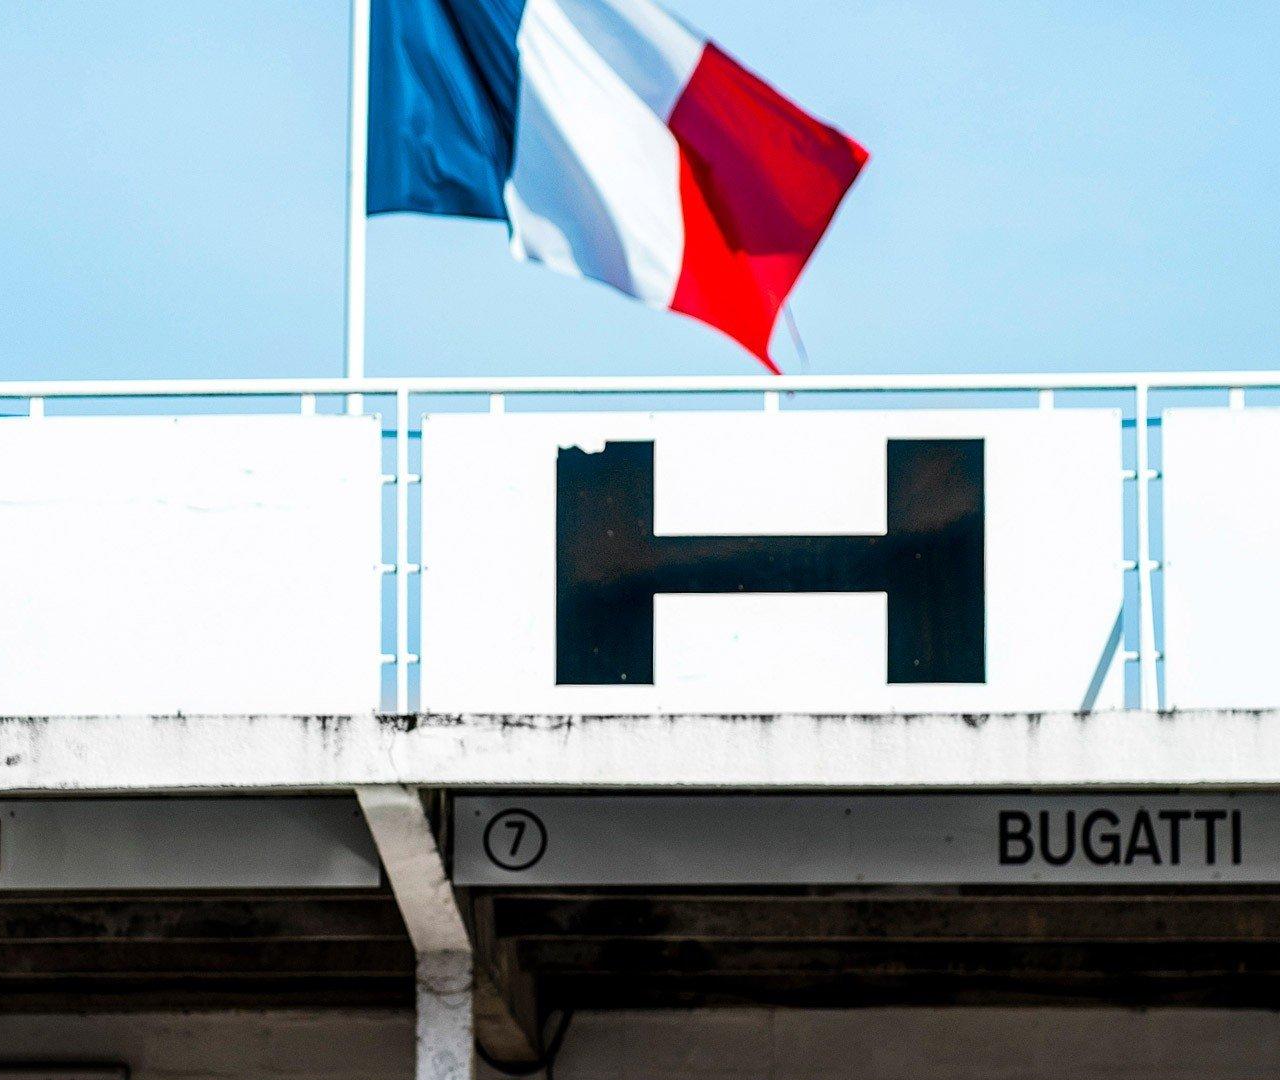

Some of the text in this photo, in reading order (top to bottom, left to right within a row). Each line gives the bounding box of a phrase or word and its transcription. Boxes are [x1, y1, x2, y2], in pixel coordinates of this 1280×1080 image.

[556, 438, 987, 686] H
[503, 819, 527, 857] 7
[997, 808, 1242, 866] BUGATTI
